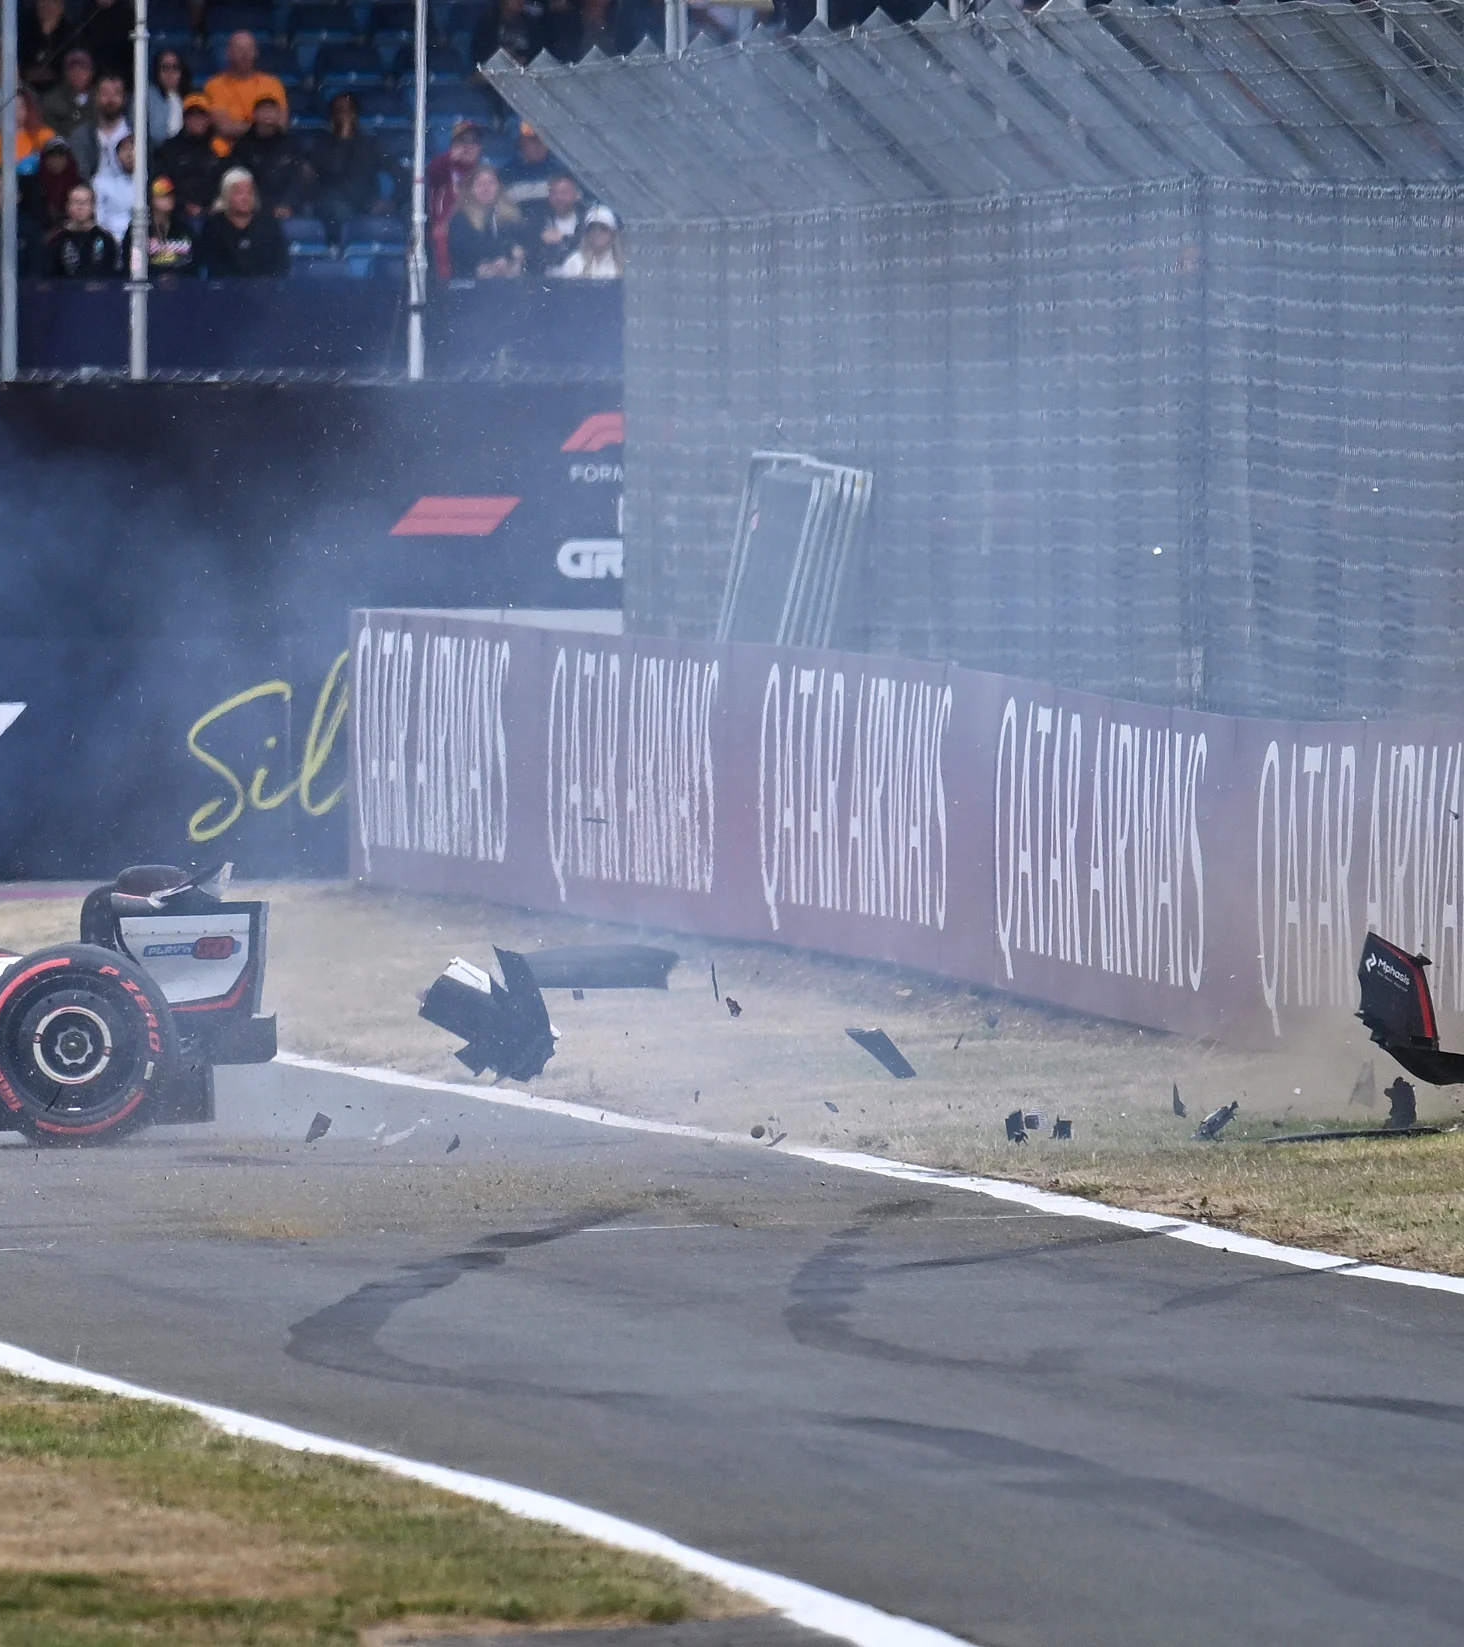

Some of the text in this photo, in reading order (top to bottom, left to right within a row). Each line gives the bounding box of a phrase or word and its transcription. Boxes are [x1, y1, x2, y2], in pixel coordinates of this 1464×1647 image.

[355, 624, 510, 873] QATAR AIRWAYS
[548, 647, 719, 903] QATAR AIRWAYS
[759, 662, 953, 931] QATAR AIRWAYS
[995, 697, 1208, 992] QATAR AIRWAYS
[120, 978, 161, 1053] ZERO
[1257, 740, 1464, 1037] QATAR AIRWA
[1377, 958, 1411, 986] Mphasis
